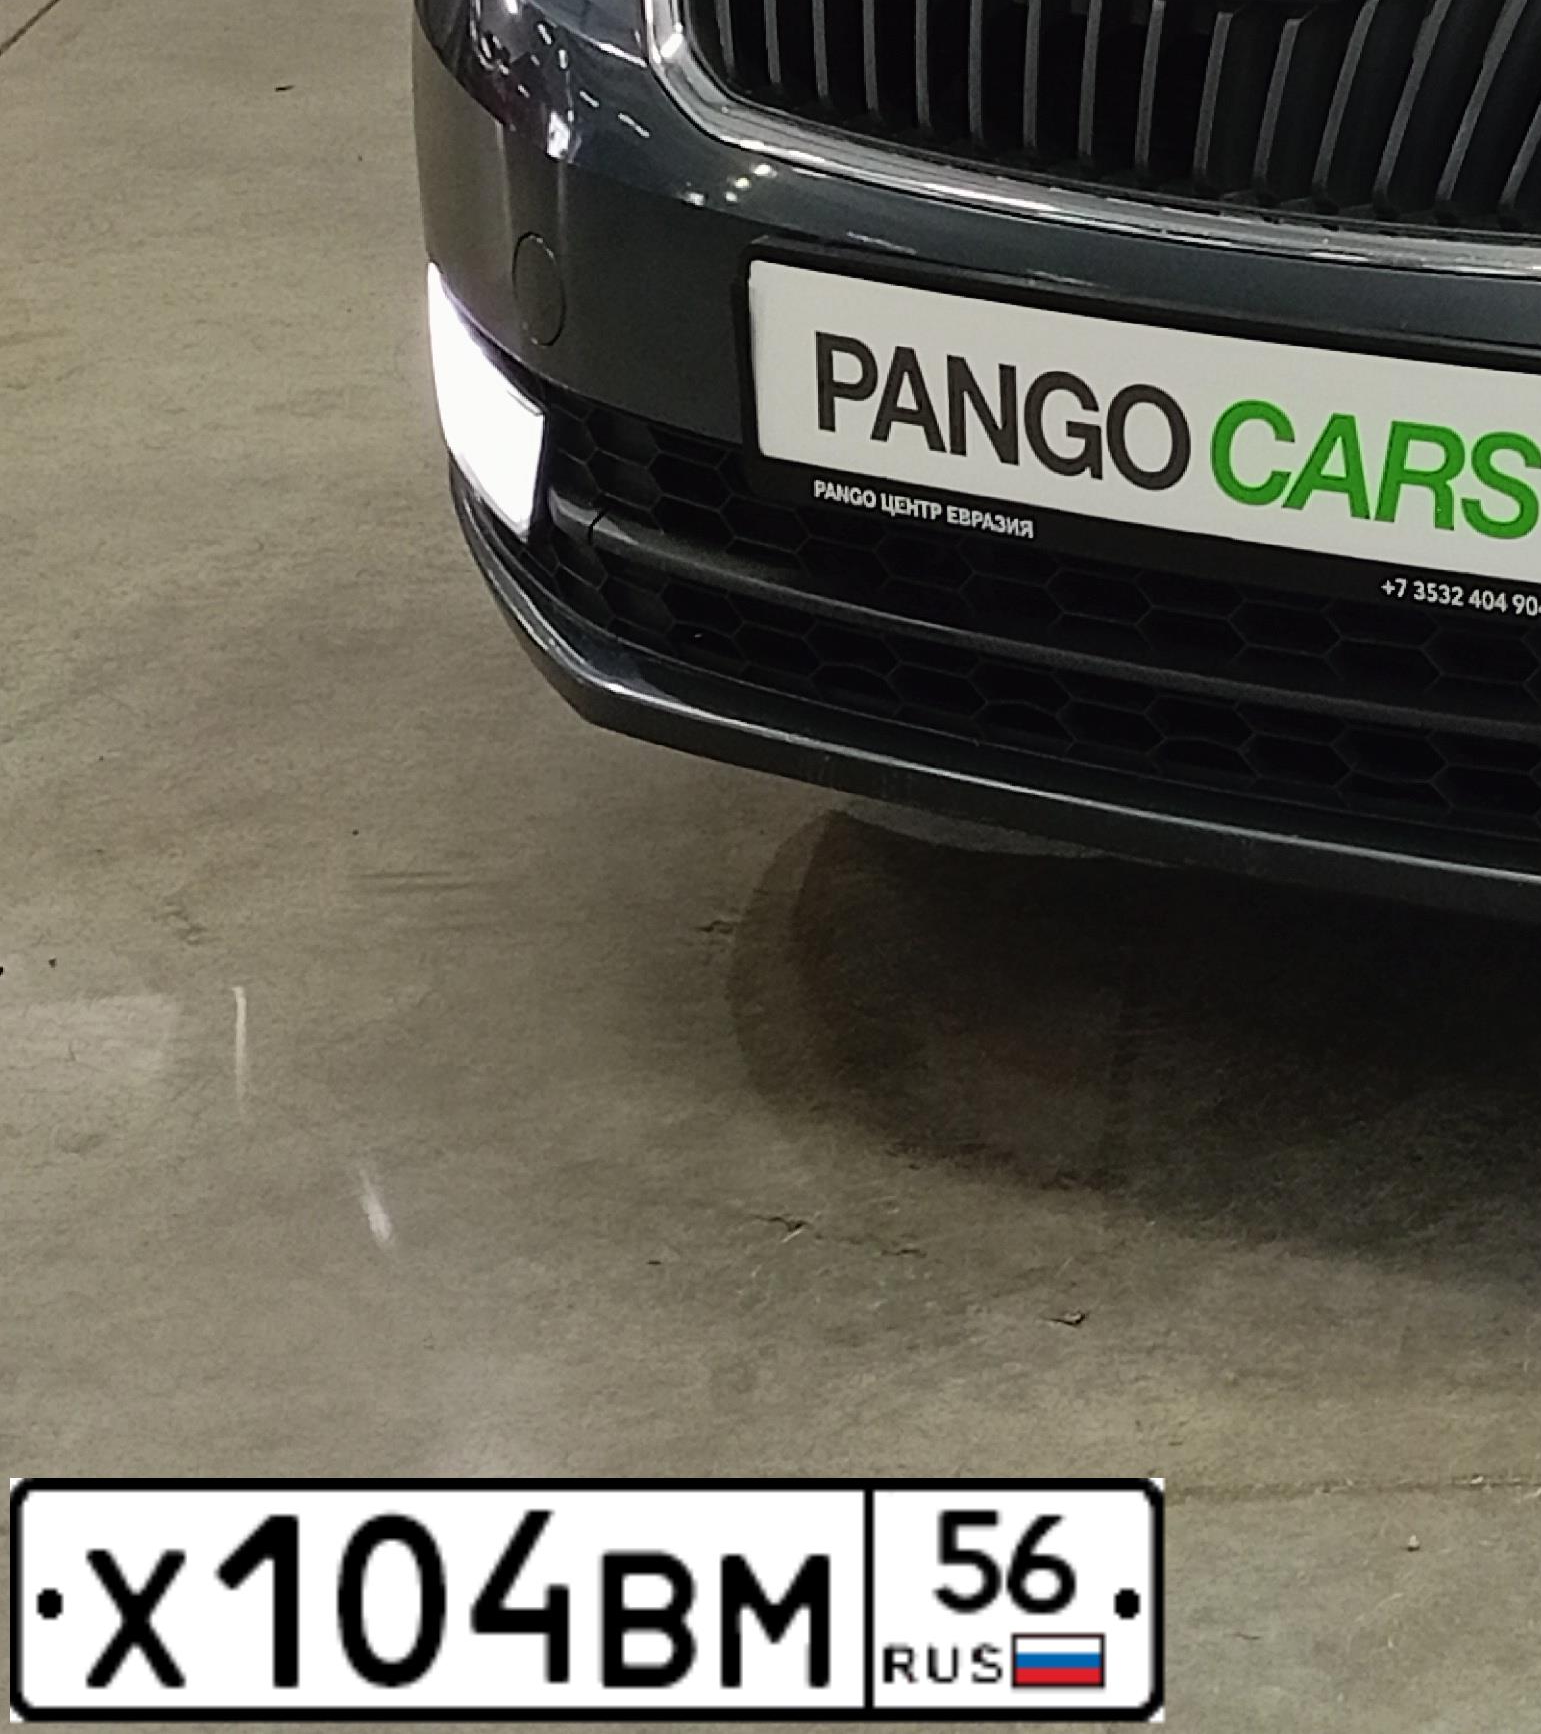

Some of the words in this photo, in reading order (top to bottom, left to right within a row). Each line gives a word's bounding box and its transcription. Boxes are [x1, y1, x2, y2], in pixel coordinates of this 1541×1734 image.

[814, 331, 1191, 491] PANGO
[813, 479, 877, 509] PANGO
[880, 492, 942, 520] ЦЕНТР
[946, 505, 1035, 539] ЕВРАЗИЯ
[1381, 578, 1408, 598] +7
[1413, 580, 1464, 607] 3532
[1468, 589, 1508, 613] 404
